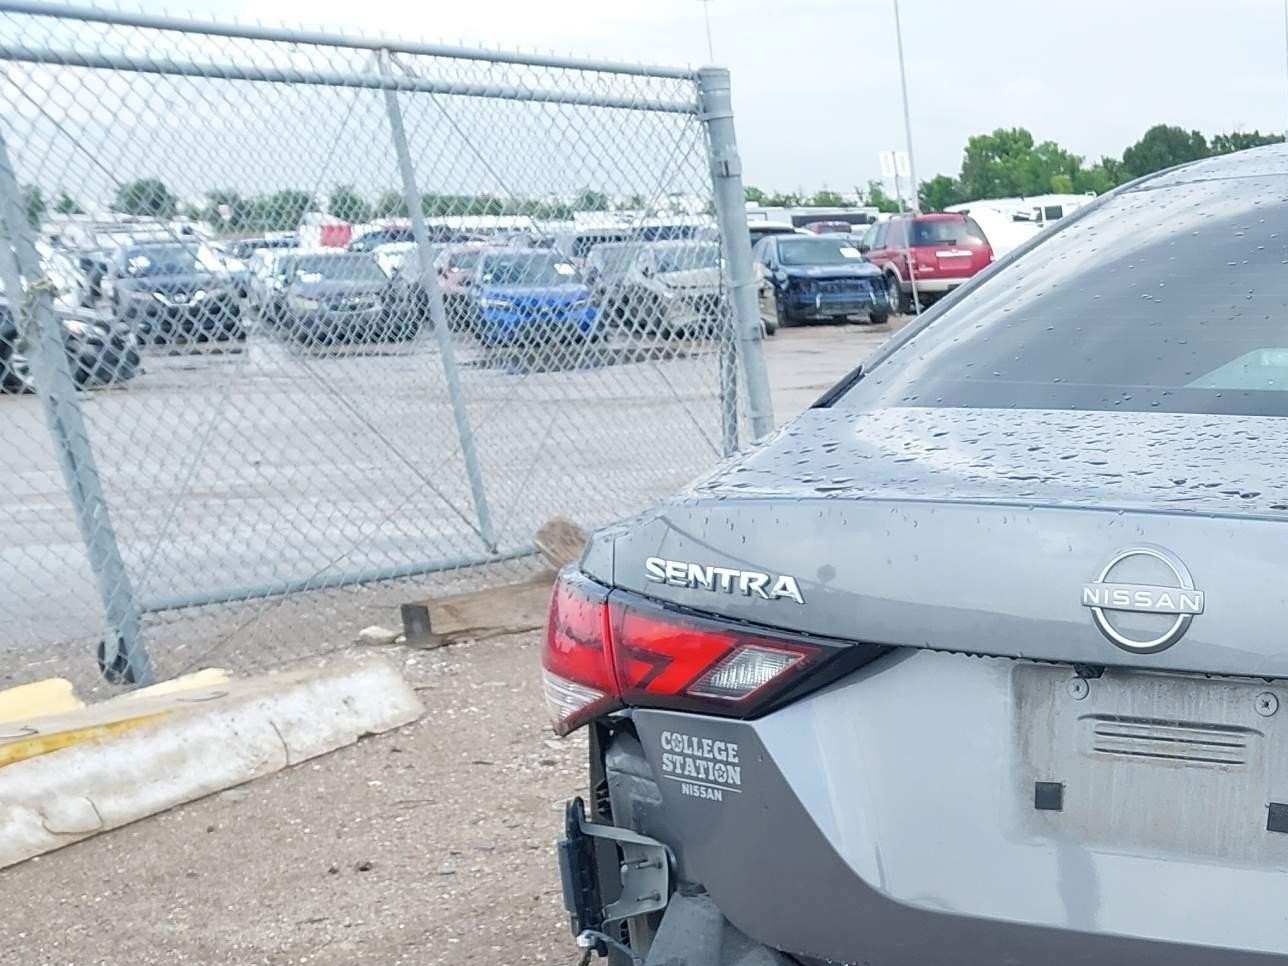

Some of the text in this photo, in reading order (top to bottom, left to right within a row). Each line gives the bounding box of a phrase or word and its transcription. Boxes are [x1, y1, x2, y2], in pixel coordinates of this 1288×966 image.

[645, 557, 805, 603] SENTRA
[1083, 587, 1201, 611] NISSAN
[661, 731, 739, 763] COLLEGE
[662, 753, 741, 785] STATION
[682, 783, 722, 801] NISSAN
